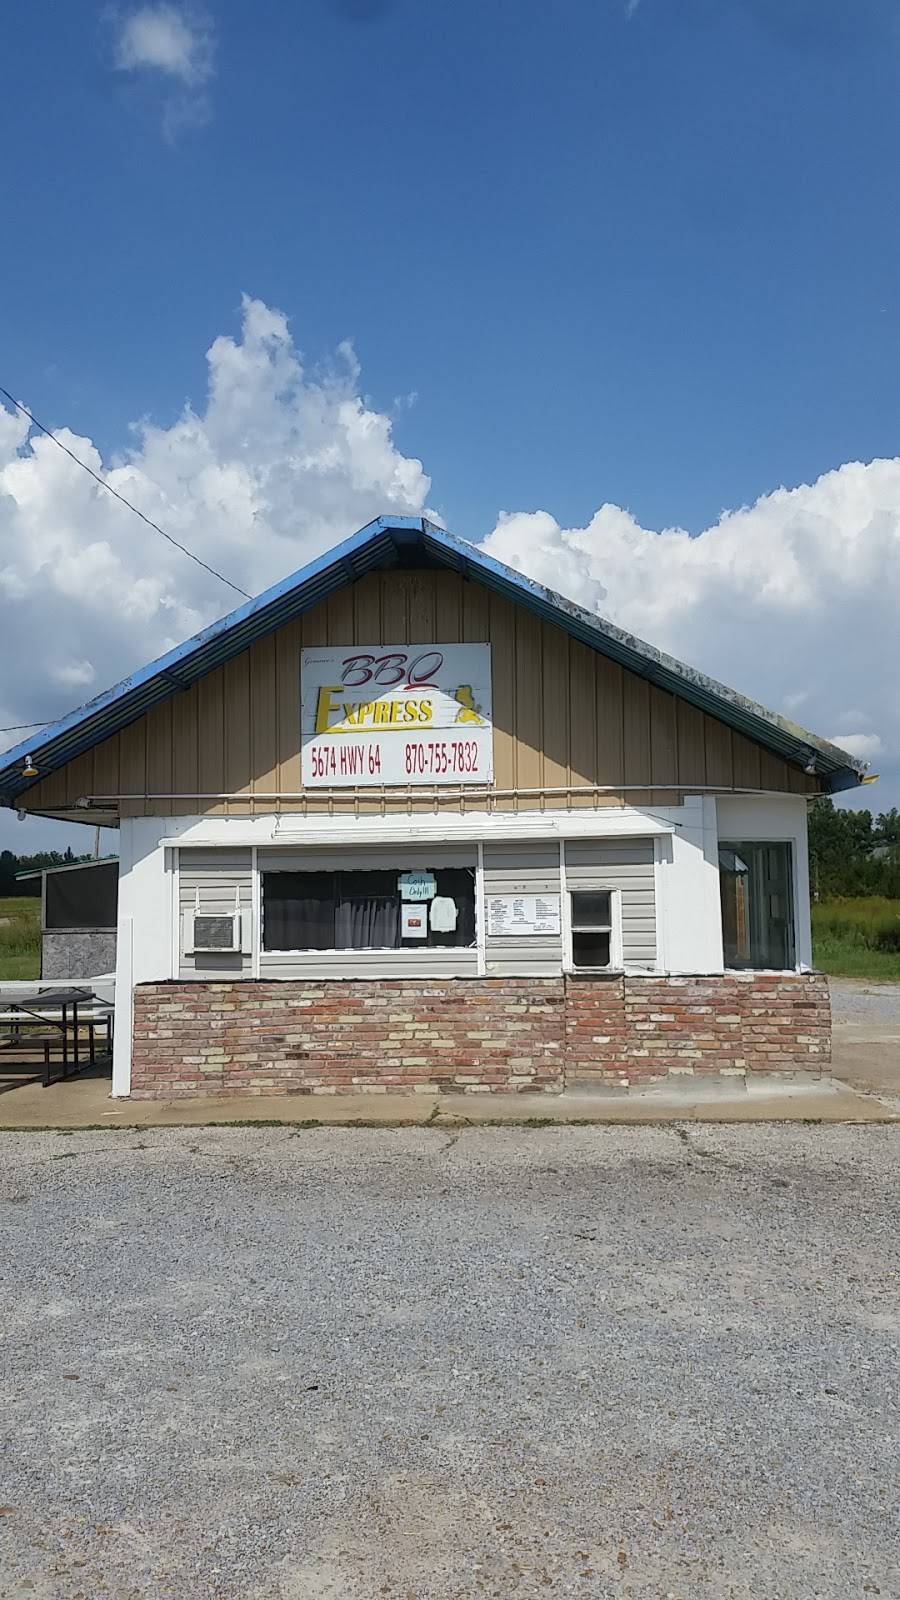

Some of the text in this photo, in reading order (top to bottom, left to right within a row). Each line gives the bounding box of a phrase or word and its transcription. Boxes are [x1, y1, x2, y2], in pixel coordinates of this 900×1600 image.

[342, 652, 443, 691] BBQ
[316, 685, 433, 733] EXPRESS
[312, 742, 478, 777] 5674 HWY 64 870-755-7832
